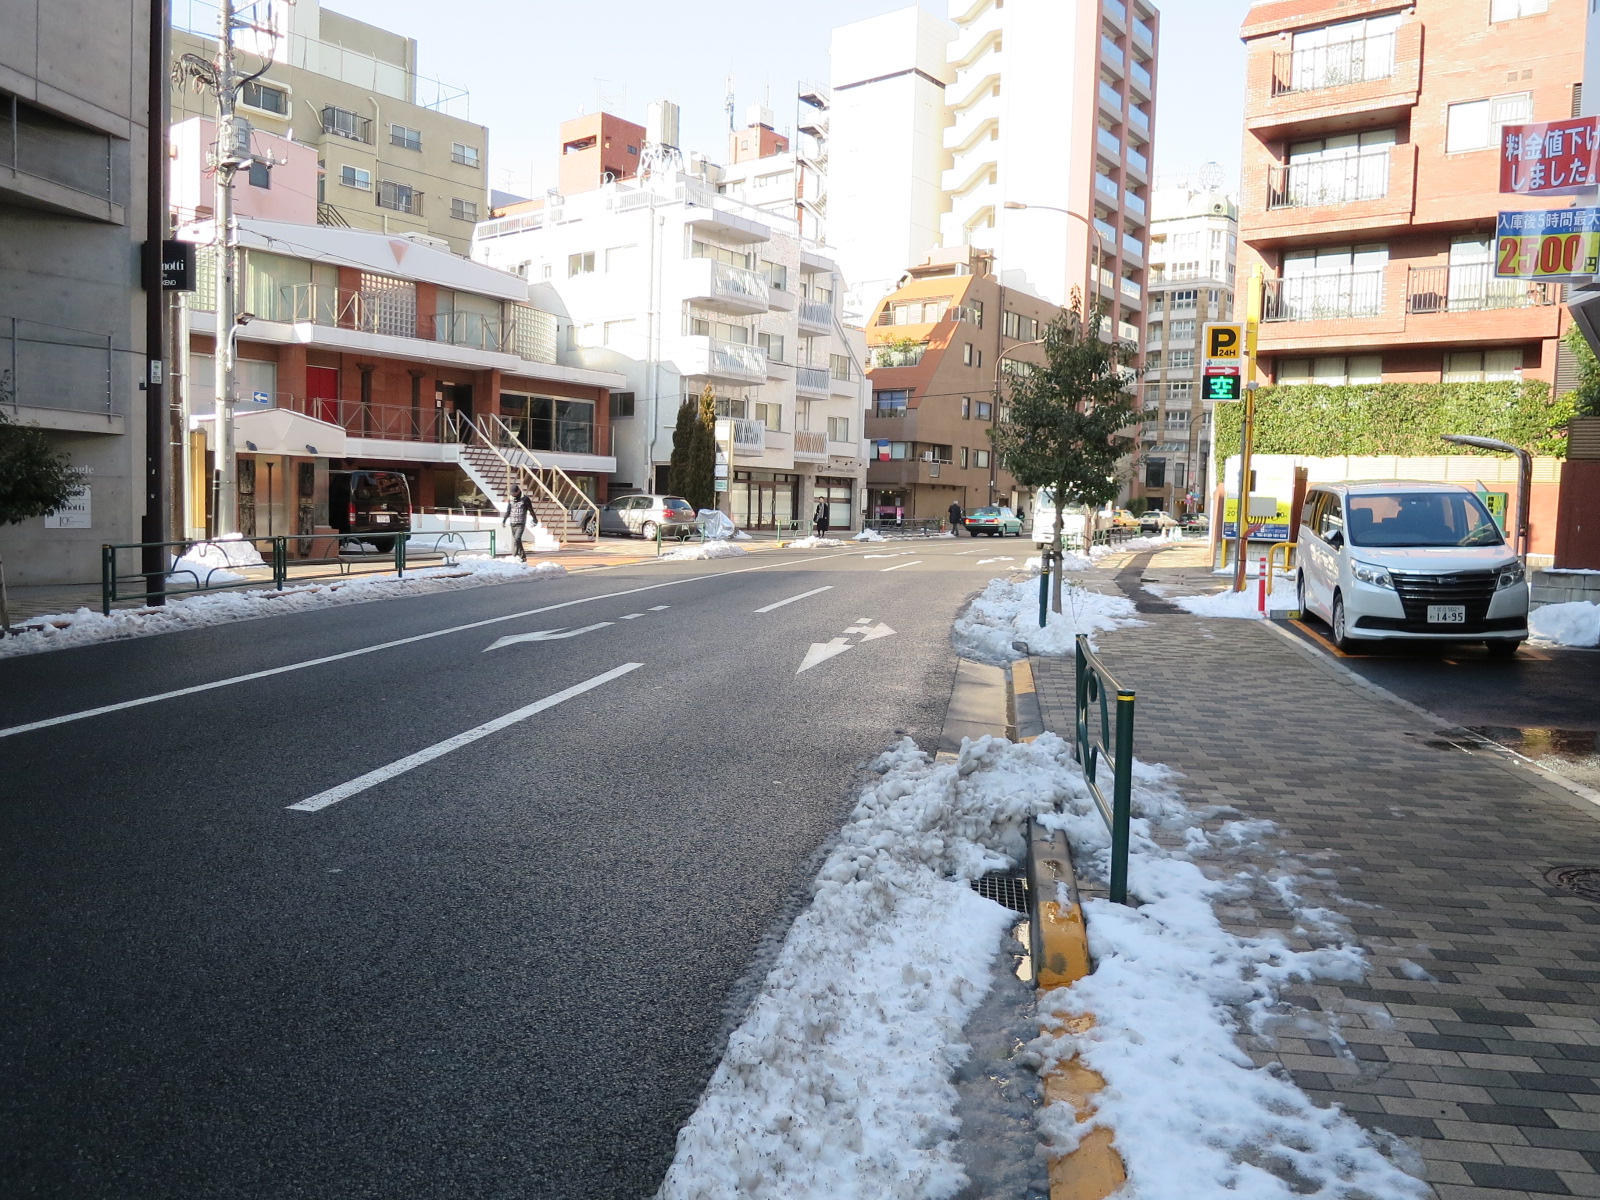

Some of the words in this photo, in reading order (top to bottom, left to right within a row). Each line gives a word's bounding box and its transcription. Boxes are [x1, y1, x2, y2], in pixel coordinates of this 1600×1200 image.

[1511, 158, 1595, 190] しました。
[1499, 210, 1600, 229] 入庫後5時間最大
[161, 259, 184, 271] notti
[1211, 328, 1236, 356] P
[1218, 349, 1236, 357] 24H
[1209, 376, 1234, 399] 空
